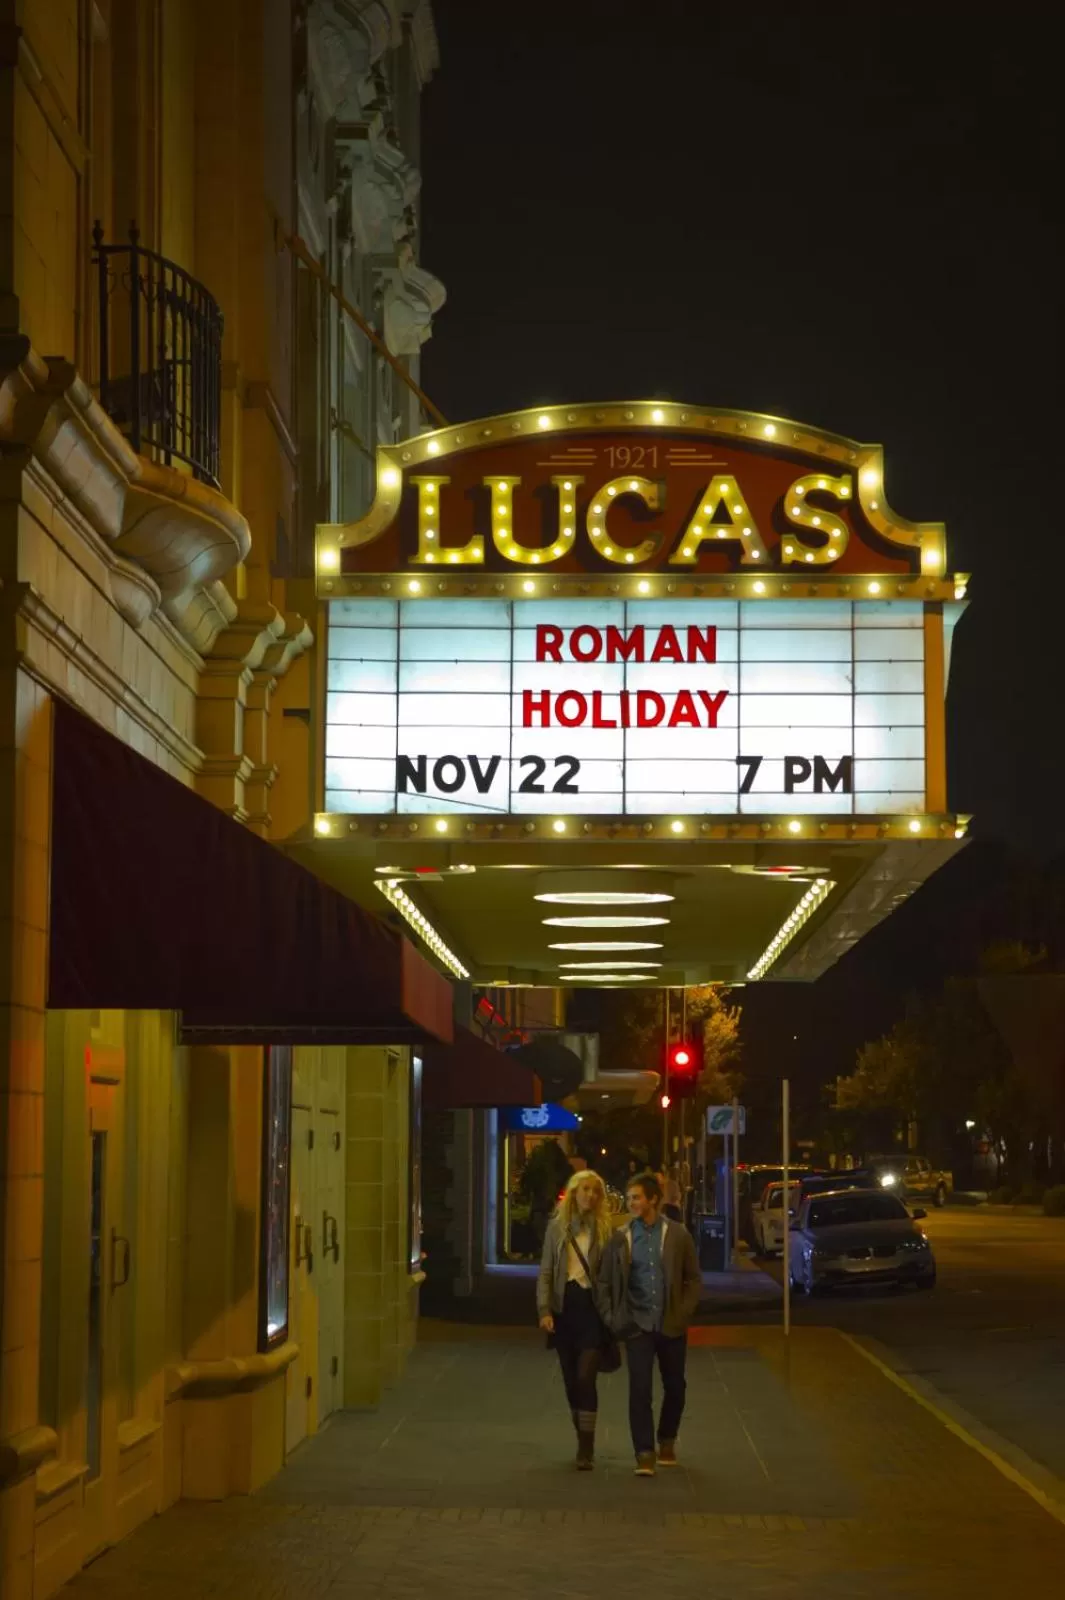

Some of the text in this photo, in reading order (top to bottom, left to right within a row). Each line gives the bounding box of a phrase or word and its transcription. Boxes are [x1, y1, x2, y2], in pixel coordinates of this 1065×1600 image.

[605, 446, 659, 469] 1921
[410, 475, 852, 565] LUCAS
[536, 624, 717, 663] ROMAN
[522, 690, 728, 728] HOLIDAY
[397, 754, 852, 794] NOV 22 7 PM
